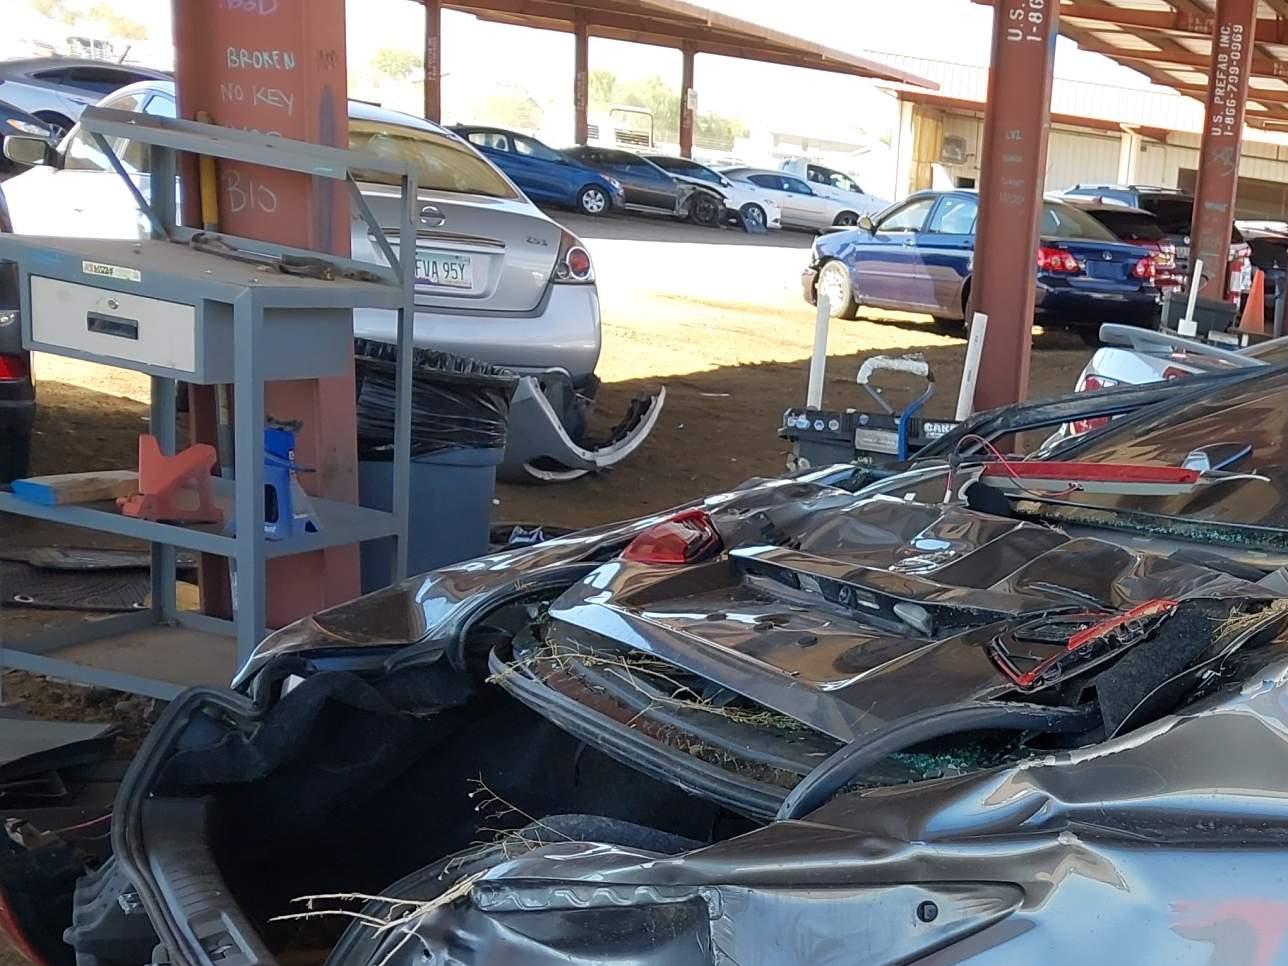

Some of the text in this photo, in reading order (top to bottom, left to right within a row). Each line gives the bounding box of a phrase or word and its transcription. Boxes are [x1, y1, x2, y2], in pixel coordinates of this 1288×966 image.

[225, 47, 295, 70] BROKEN
[1214, 54, 1229, 104] PREFAB
[1223, 24, 1243, 136] 1-866-799-0969
[220, 83, 294, 116] NO KEY
[1211, 111, 1224, 136] U.S.
[442, 262, 465, 280] 95Y
